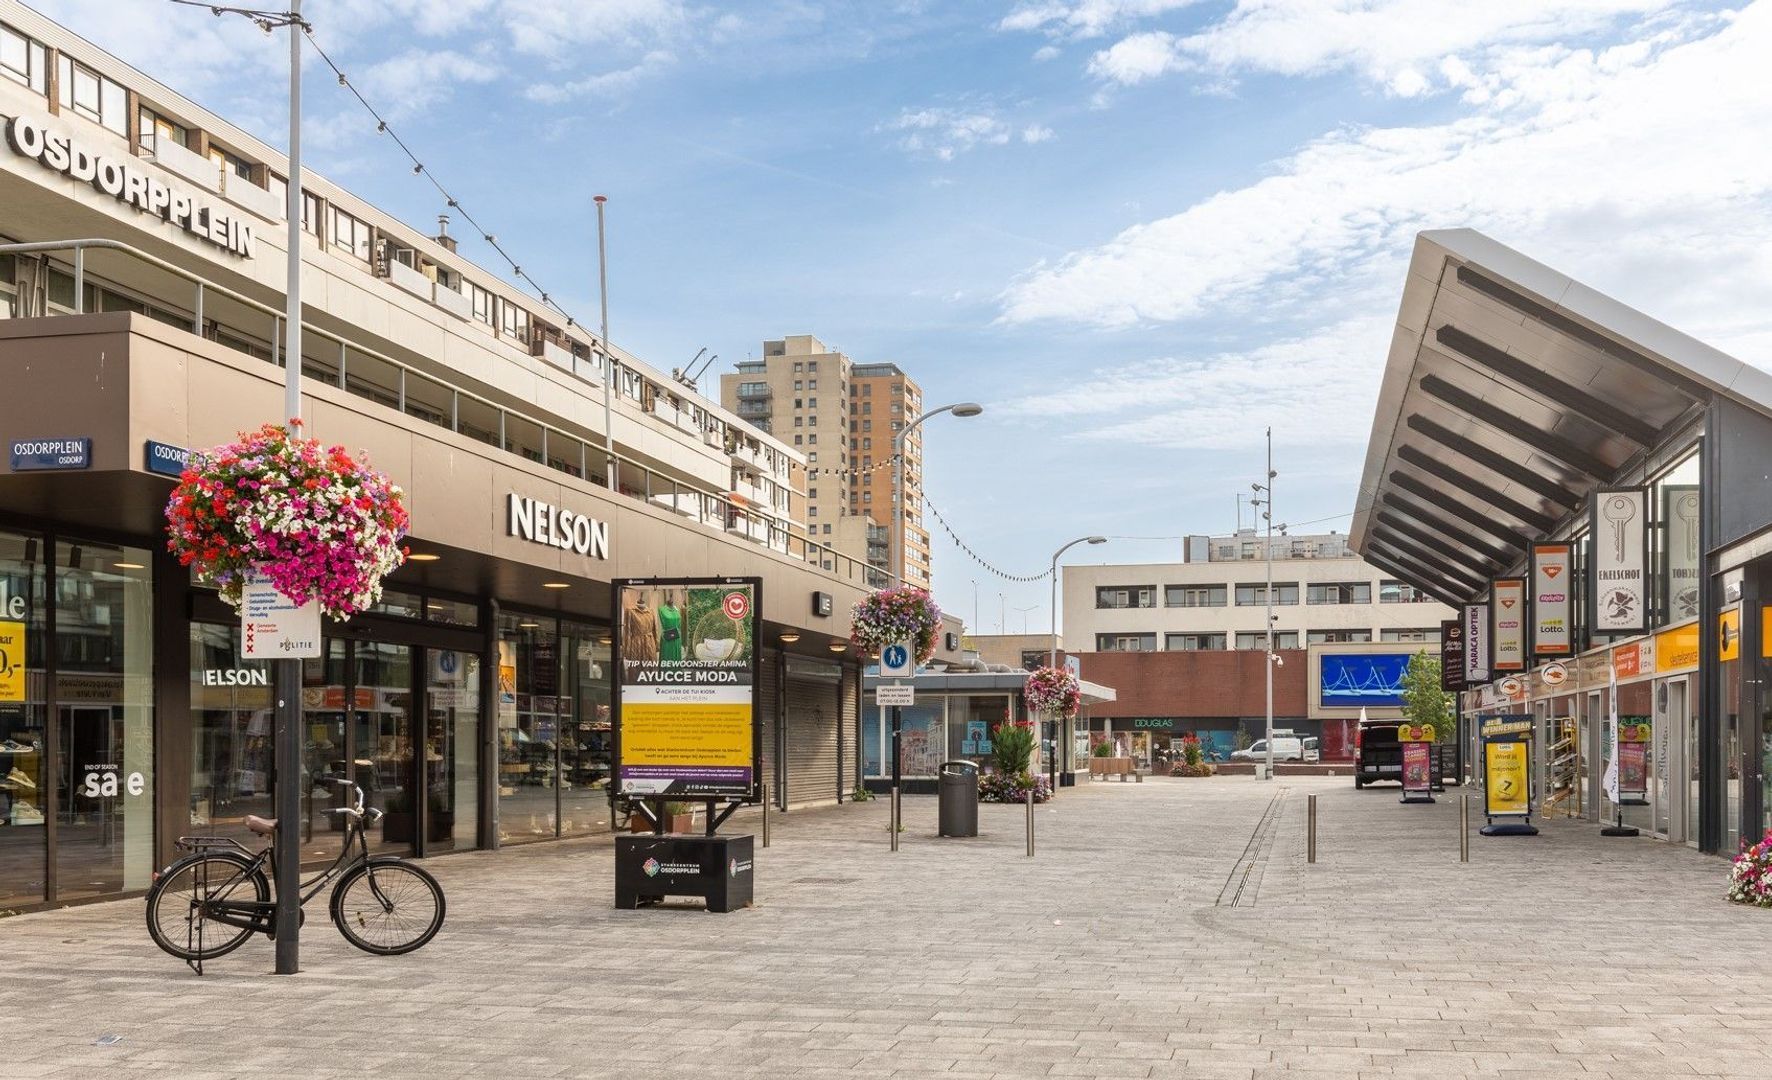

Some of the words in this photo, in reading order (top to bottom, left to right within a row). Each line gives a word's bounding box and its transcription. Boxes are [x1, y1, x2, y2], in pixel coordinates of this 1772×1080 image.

[9, 113, 255, 260] OSDORPPLEIN
[14, 441, 83, 456] OSDORPPLEIN
[58, 455, 83, 465] OSDORP
[509, 492, 609, 560] NELSON
[1470, 607, 1479, 635] OPTIEK
[1470, 636, 1479, 668] KARACA
[627, 660, 641, 668] TIP
[641, 660, 659, 668] VAN
[660, 660, 719, 668] BEWOONSTER
[719, 660, 747, 668] AMINA
[202, 668, 268, 686] ELSON
[637, 671, 692, 682] AYUCCE
[695, 671, 738, 682] MODA
[1134, 718, 1173, 727] DOUGLAS
